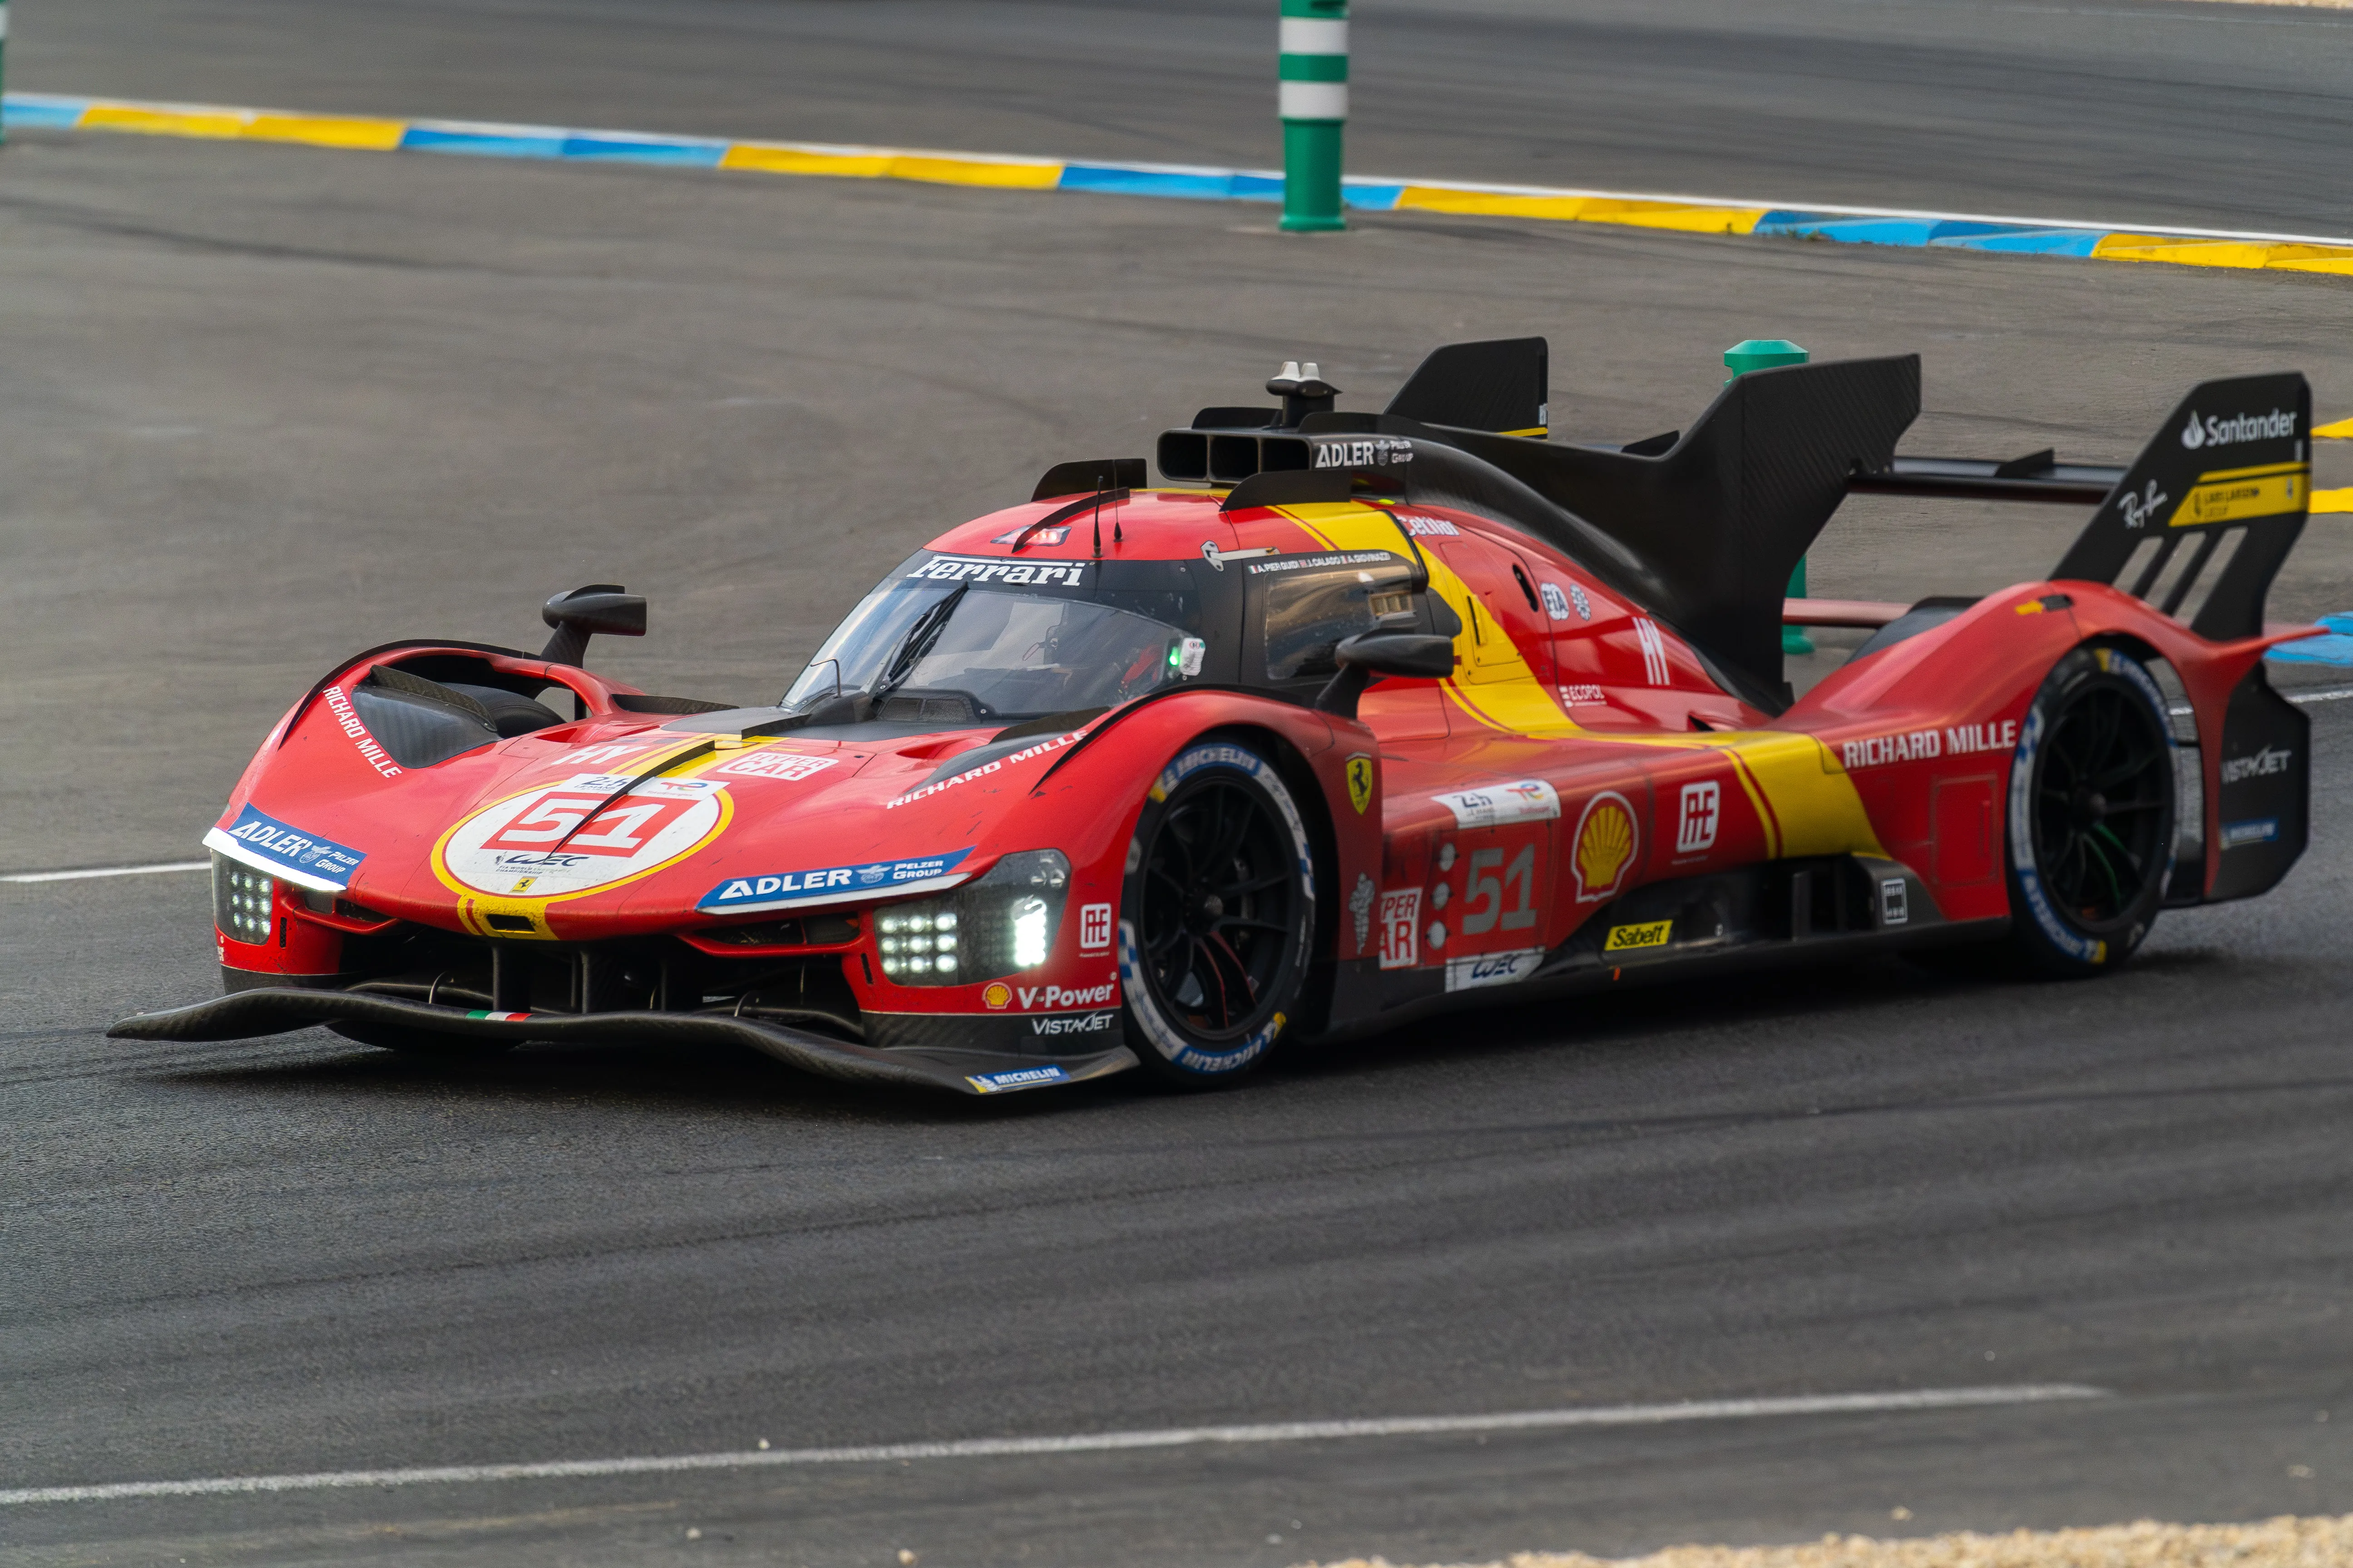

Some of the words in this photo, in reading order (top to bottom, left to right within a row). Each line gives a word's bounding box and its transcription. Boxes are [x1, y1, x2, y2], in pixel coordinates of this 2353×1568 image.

[2205, 407, 2297, 447] Santander
[1315, 441, 1374, 468] ADLER
[906, 554, 1086, 586] Ferrari
[1542, 590, 1568, 612] FIA
[322, 685, 366, 738] RICHARD
[355, 738, 403, 778] MILLE
[1842, 729, 1941, 770] RICHARD
[1945, 719, 2017, 755] MILLE
[551, 746, 648, 765] HY
[728, 761, 812, 777] CAR
[750, 754, 830, 767] HYPER
[1176, 747, 1257, 776] MICHELIN
[887, 761, 1002, 809] RICHARD
[498, 798, 666, 849] 51
[228, 821, 313, 857] ADLER
[315, 859, 346, 874] GROUP
[328, 851, 360, 866] PELZER
[504, 854, 590, 867] WEC
[894, 860, 944, 871] PELZER
[718, 869, 853, 900] ADLER
[893, 868, 942, 880] GROUP
[1462, 843, 1537, 936] 51
[1381, 921, 1412, 962] AR
[1613, 925, 1663, 948] Sabelt
[1017, 983, 1114, 1010] V-Power
[1031, 1011, 1114, 1035] VISTAJET
[994, 1066, 1061, 1085] MICHELIN
